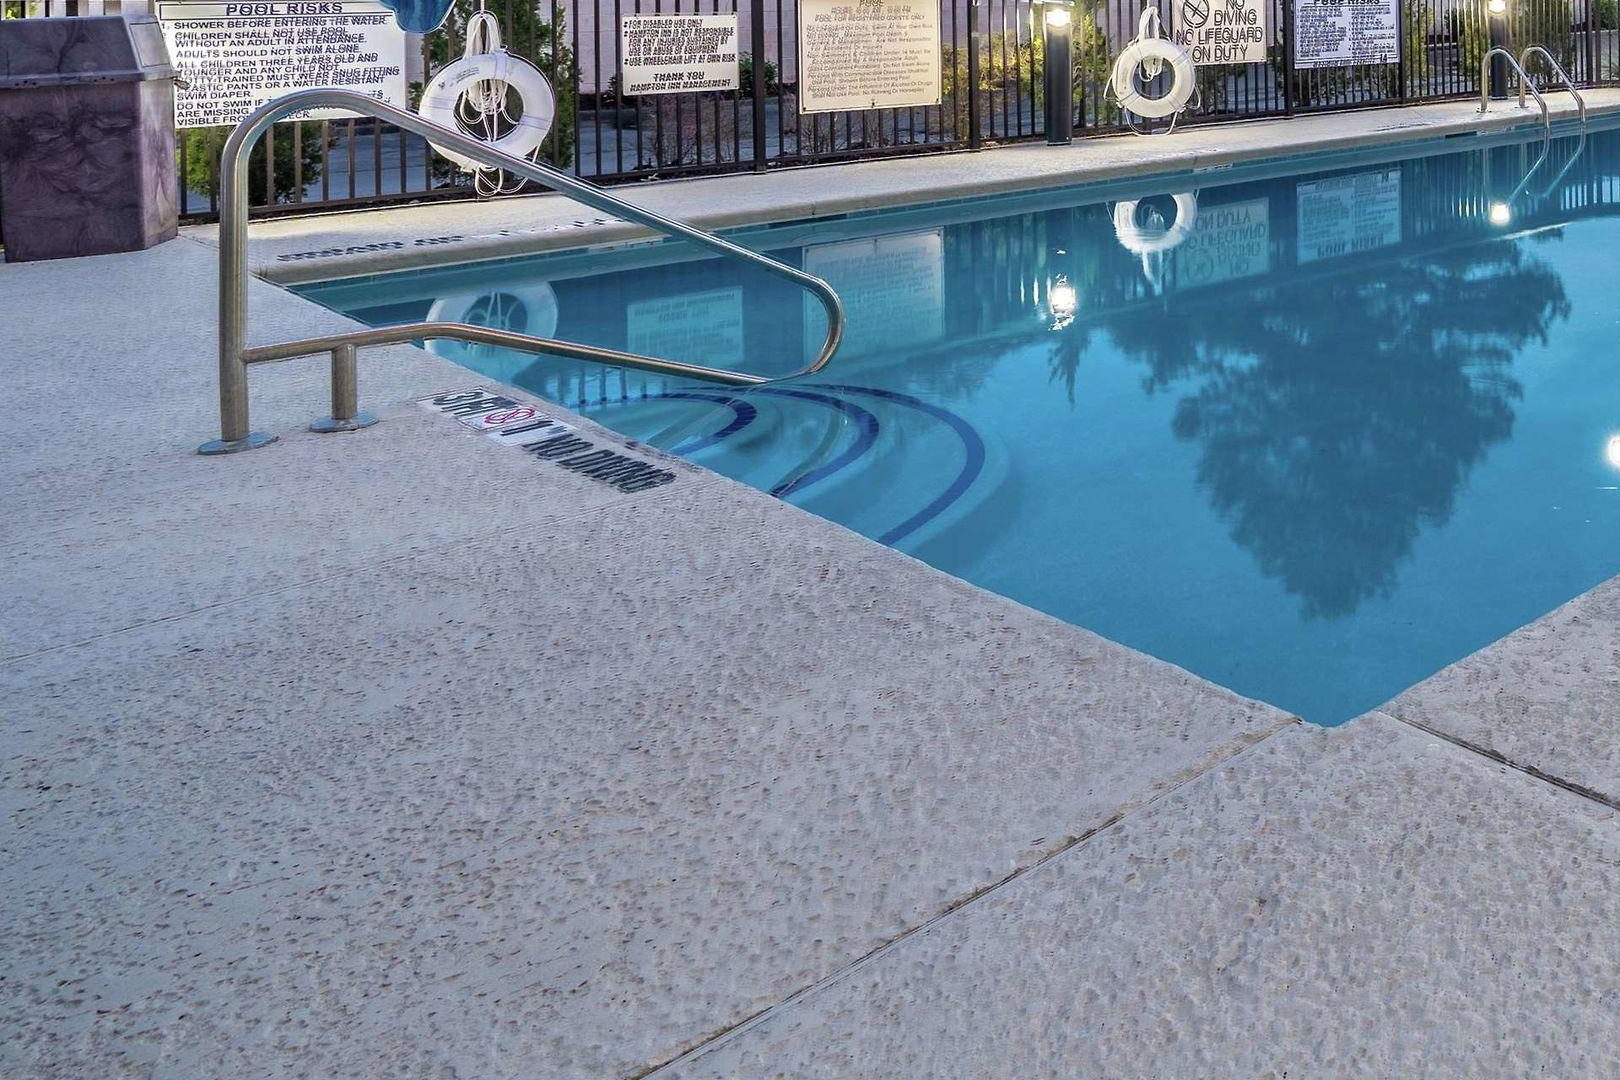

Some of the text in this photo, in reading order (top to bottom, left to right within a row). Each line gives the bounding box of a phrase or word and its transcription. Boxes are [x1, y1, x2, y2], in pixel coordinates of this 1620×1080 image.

[226, 1, 343, 16] POOL RISKS
[174, 21, 225, 29] SHOWER
[227, 19, 271, 29] BEFORE
[274, 16, 327, 27] ENTERING
[329, 16, 349, 26] THE
[628, 18, 703, 29] FOR DISABLED USE ONLY
[1214, 8, 1258, 26] DIVING
[174, 26, 349, 40] CHILDREN SHALL NOT USE POOL
[628, 29, 660, 39] HAMPTON
[660, 29, 672, 38] INN
[681, 28, 694, 37] NOT
[1176, 26, 1263, 45] NO LIFEGUARD
[175, 39, 226, 48] WITHOUT
[229, 39, 244, 47] AN
[247, 38, 281, 47] ADULT
[284, 37, 295, 45] IN
[628, 38, 641, 48] FOR
[176, 49, 220, 58] ADULTS
[222, 48, 268, 58] SHOULD
[270, 46, 293, 56] NOT
[295, 45, 322, 56] SWIM
[628, 47, 641, 57] USE
[1192, 43, 1249, 63] ON DUTY
[176, 52, 378, 69] ALL CHILDREN THREE YEARS OLD AND
[629, 57, 641, 67] USE
[643, 55, 683, 66] WHEELCHAIR
[684, 54, 697, 65] LIFT
[721, 53, 736, 63] RISK
[234, 67, 258, 75] AND
[260, 66, 281, 74] ANY
[284, 63, 316, 73] CHILD
[317, 62, 341, 72] NOT
[186, 74, 264, 84] OTTY-TRAINED
[266, 72, 295, 81] MUST
[298, 71, 330, 81] WEAR
[331, 67, 361, 79] SNUG
[654, 71, 705, 82] THANK YOU
[177, 74, 385, 92] ASTIC PANTS OR A WATER RESISTANT
[630, 79, 731, 92] HAMPTON INN MANAGEMENT
[176, 92, 207, 101] SWIM
[176, 102, 194, 110] DO
[196, 101, 220, 109] NOT
[222, 99, 252, 108] SWIM
[254, 98, 264, 106] IF
[176, 110, 200, 118] ARE
[176, 110, 313, 126] VISIBLE FRO ECK.
[432, 391, 484, 407] 3
[521, 433, 595, 461] NO
[555, 449, 678, 494] DIVING
